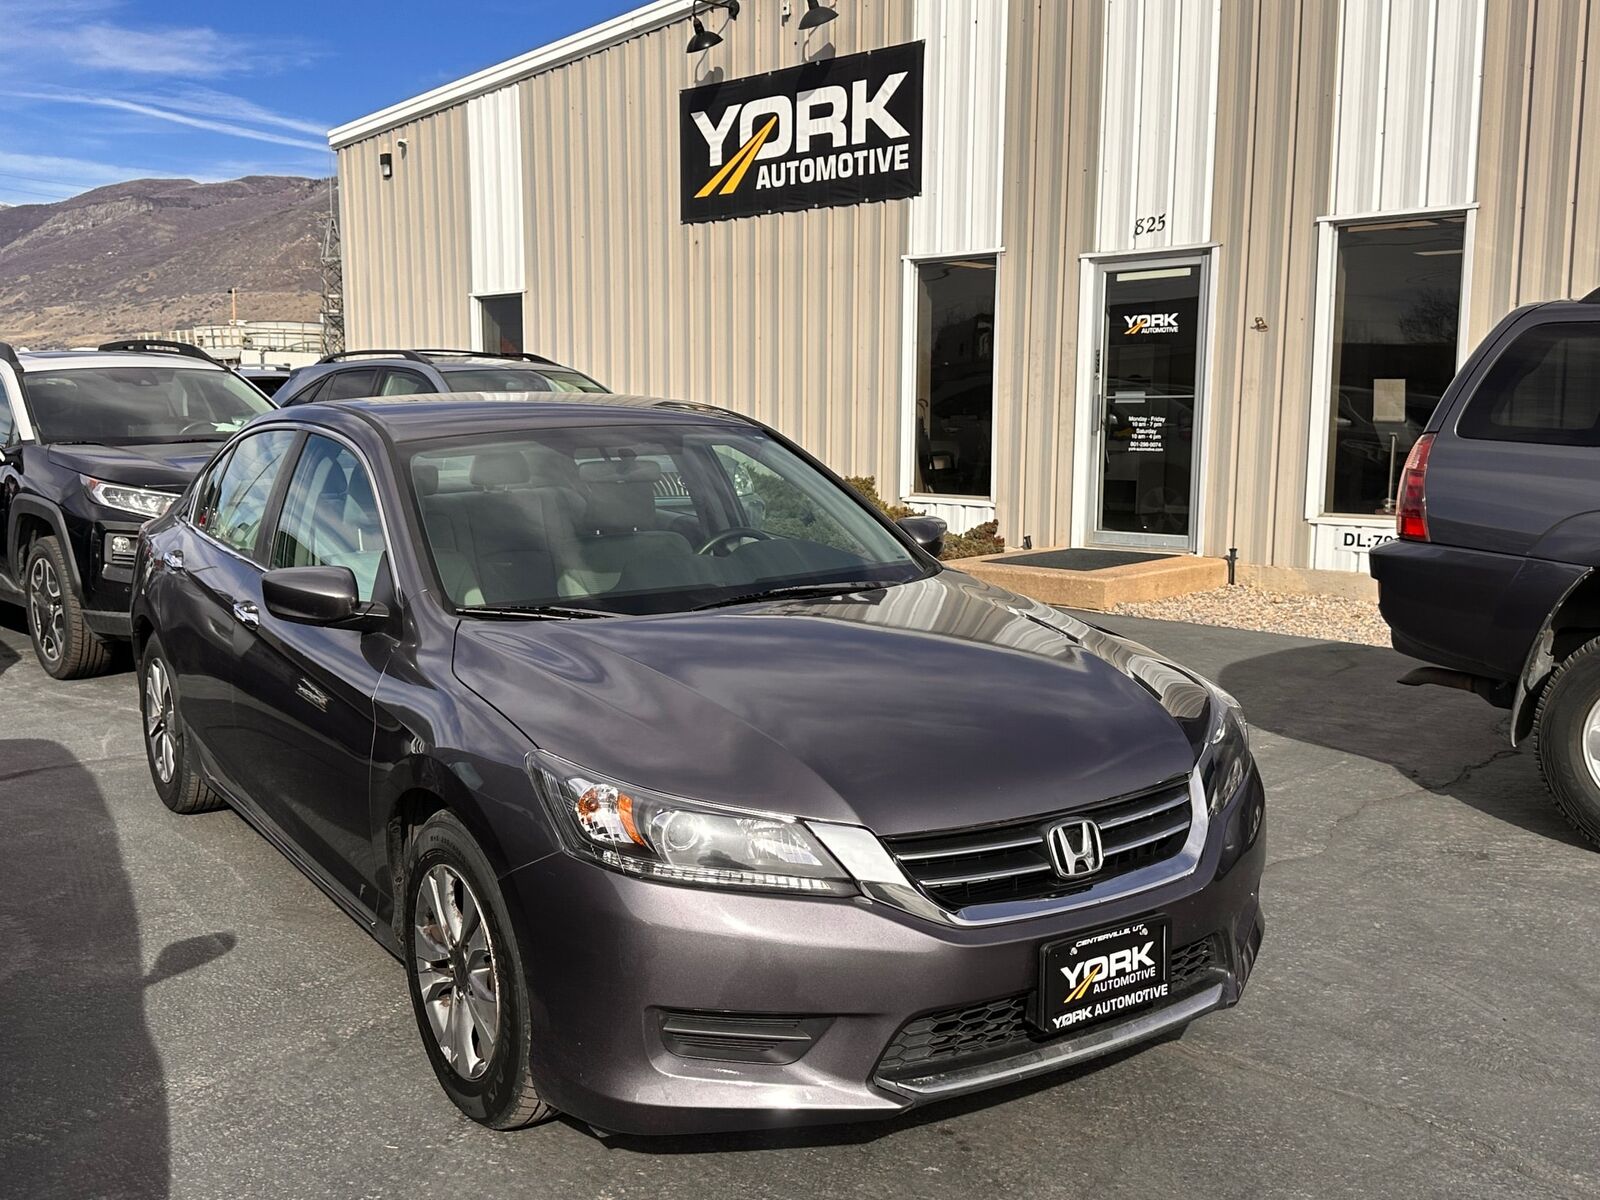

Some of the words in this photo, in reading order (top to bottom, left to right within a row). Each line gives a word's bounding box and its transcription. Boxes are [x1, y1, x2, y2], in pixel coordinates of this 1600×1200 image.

[690, 71, 910, 167] YORK
[756, 144, 909, 189] AUTOMOTIVE
[1134, 213, 1166, 235] 825
[1123, 312, 1179, 328] YORK
[1141, 326, 1179, 334] AUTOMOTIVE
[1128, 415, 1148, 423] Monday
[1151, 415, 1166, 423] Friday
[1075, 927, 1131, 947] CENTERVILLE,
[1132, 923, 1145, 932] UT
[1060, 941, 1156, 989] YORK
[1093, 966, 1156, 994] AUTOMOTIVE
[1052, 1006, 1093, 1029] YORK
[1094, 984, 1168, 1016] AUTOMOTIVE
